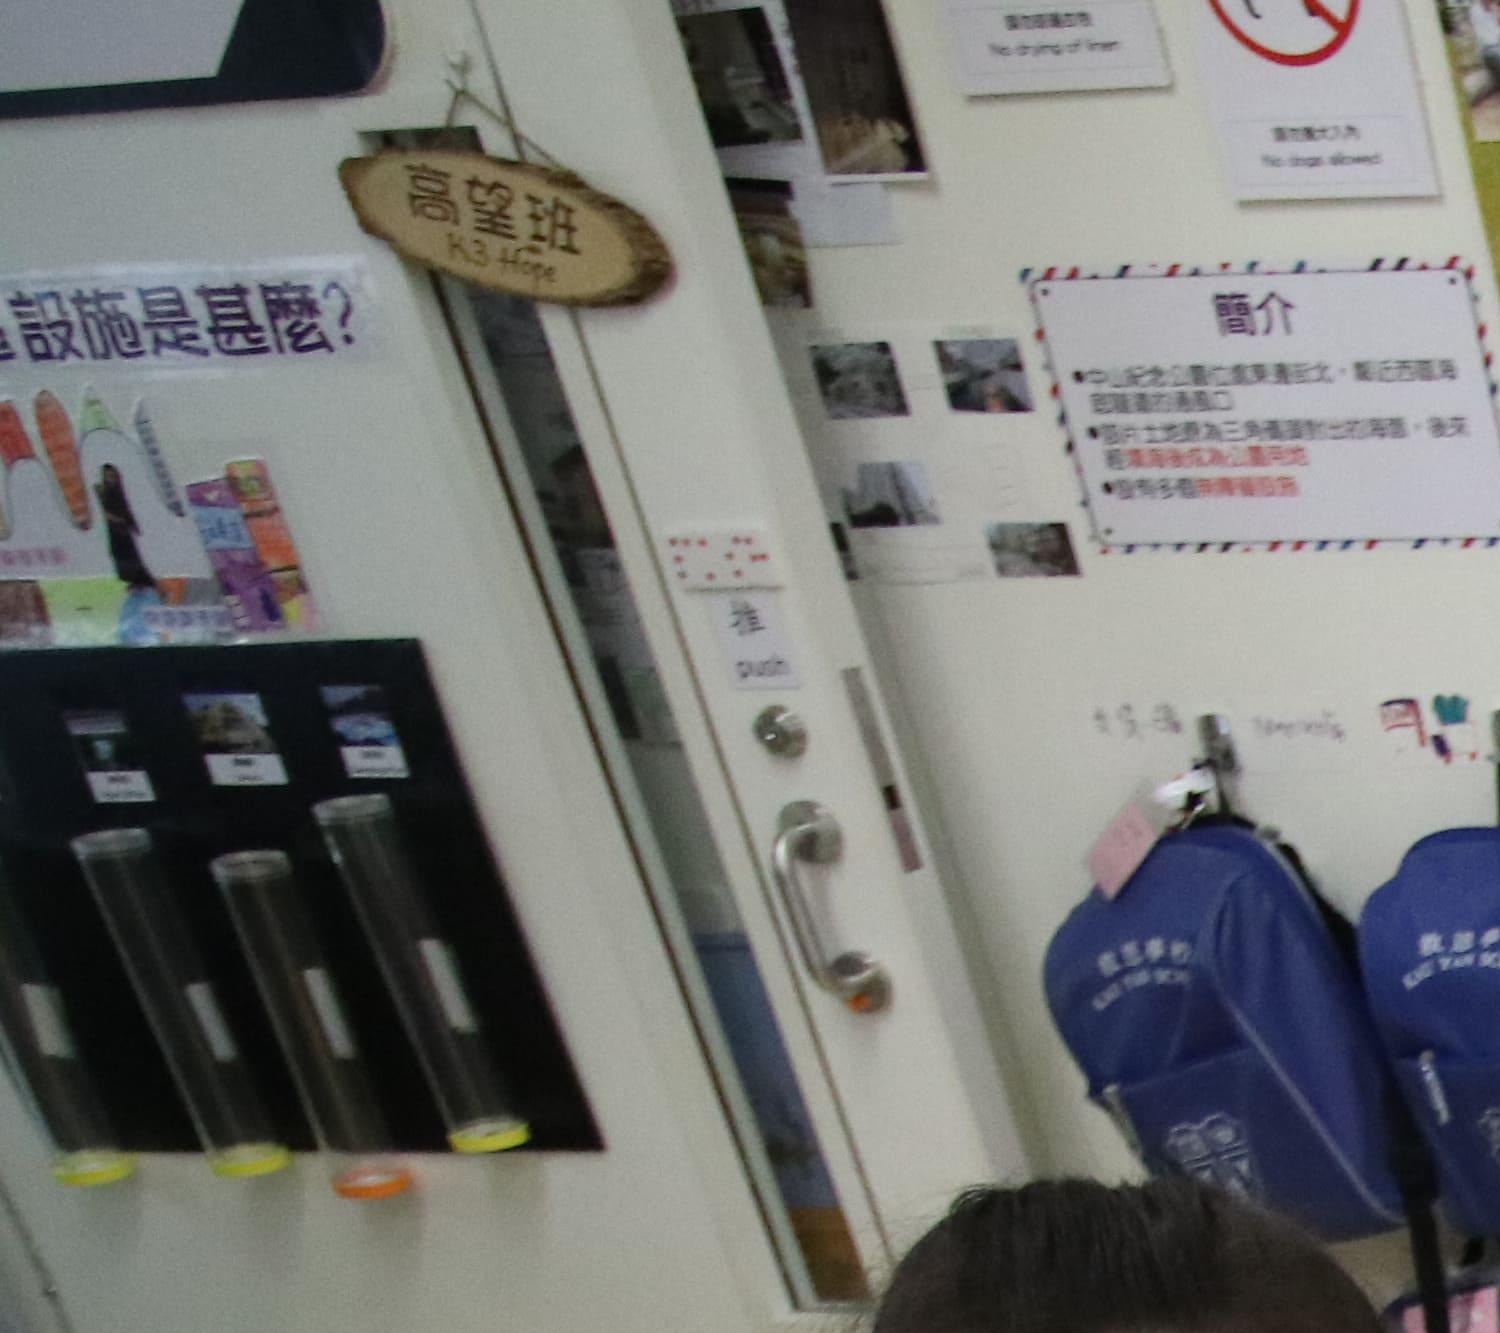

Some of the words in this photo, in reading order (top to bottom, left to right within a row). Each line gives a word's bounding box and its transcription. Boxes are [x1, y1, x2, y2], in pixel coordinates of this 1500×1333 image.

[0, 281, 356, 363] 設施是甚麼?
[1213, 291, 1296, 337] 簡介
